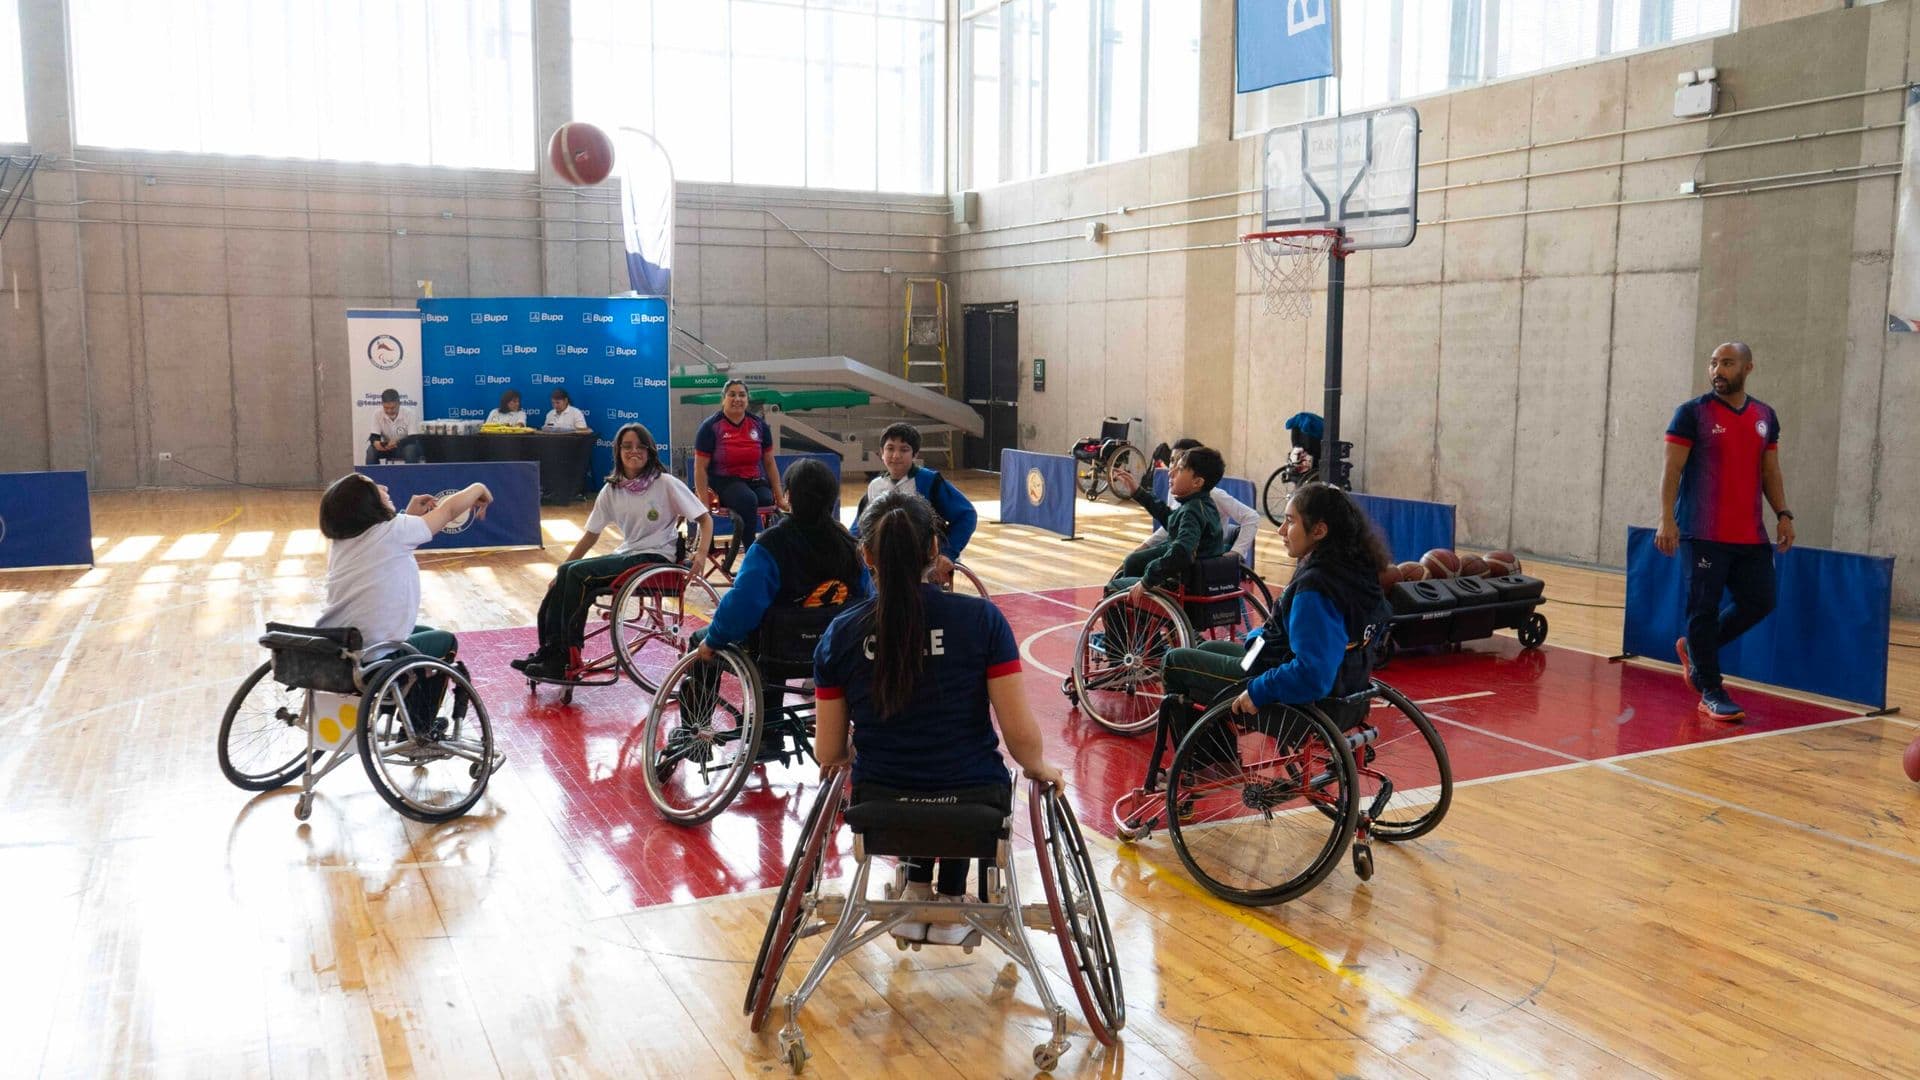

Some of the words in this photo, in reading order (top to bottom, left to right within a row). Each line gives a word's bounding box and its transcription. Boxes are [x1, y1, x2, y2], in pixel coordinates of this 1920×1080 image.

[426, 313, 449, 322] Bupa
[483, 313, 509, 323] Bupa
[541, 312, 564, 321] Bupa
[593, 313, 613, 323] Bupa
[641, 313, 665, 323] Bupa
[456, 345, 481, 356] Bupa
[514, 344, 538, 355] Bupa
[567, 345, 589, 355] Bupa
[616, 347, 637, 356] Bupa
[431, 376, 454, 386] Bupa
[487, 374, 511, 384] Bupa
[543, 375, 565, 384] Bupa
[593, 376, 615, 386] Bupa
[644, 377, 667, 387] Bupa
[460, 408, 484, 417] Bupa
[617, 409, 639, 419] Bupa
